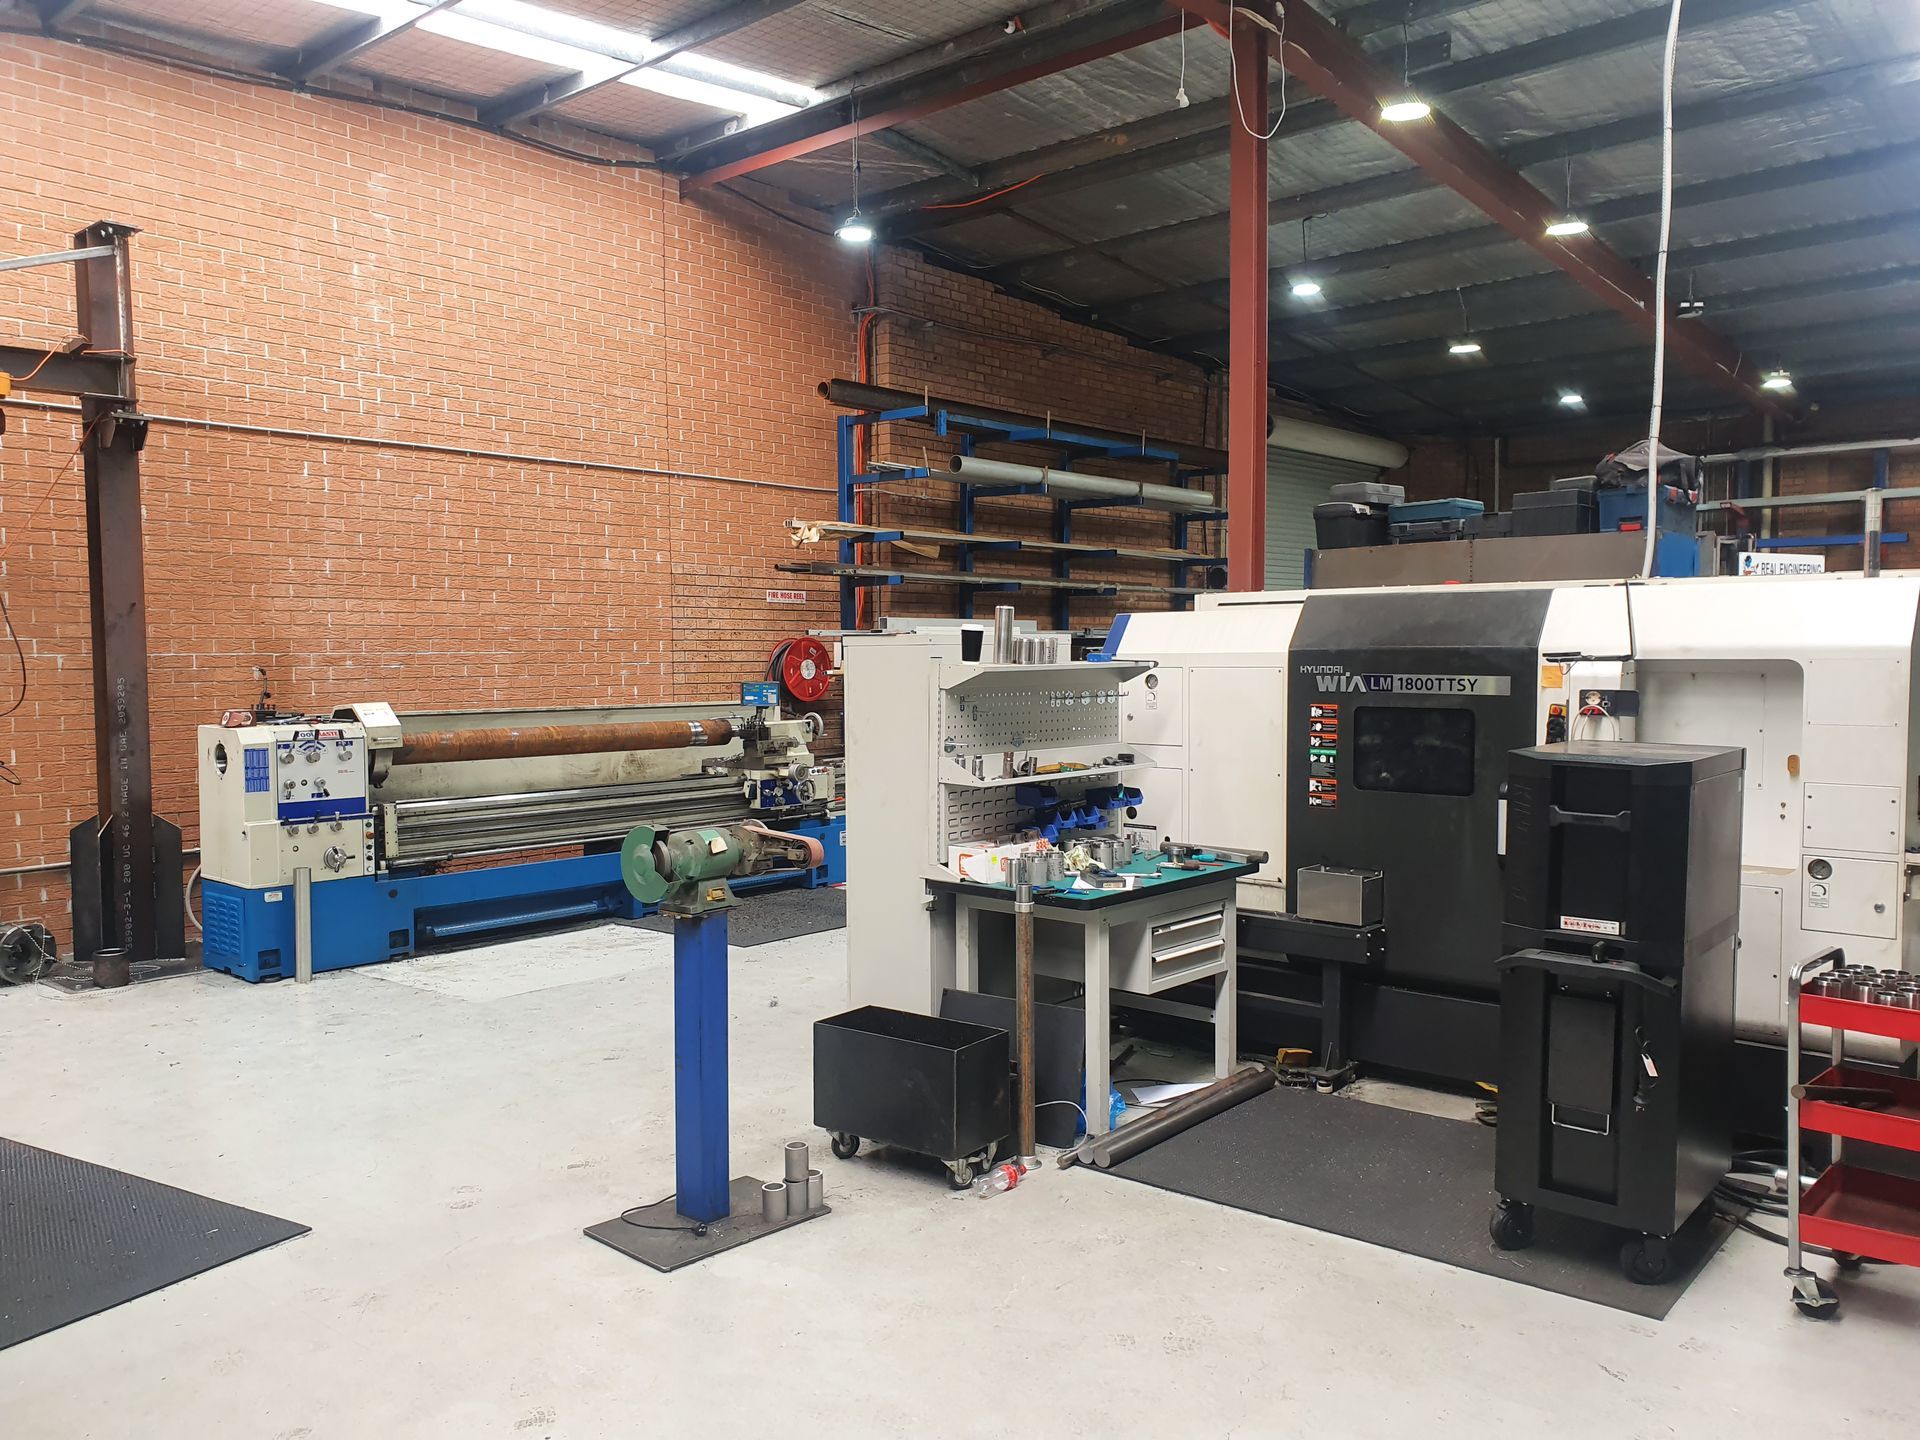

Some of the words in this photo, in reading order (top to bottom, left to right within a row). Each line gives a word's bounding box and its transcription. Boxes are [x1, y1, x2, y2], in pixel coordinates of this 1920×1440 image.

[768, 591, 779, 599] FIRE
[794, 592, 804, 600] REEL
[1299, 665, 1343, 674] HYUNDAI
[1370, 680, 1392, 691] LM
[1397, 677, 1478, 693] 1800TTSY
[120, 757, 128, 770] IN
[120, 778, 129, 804] MADE
[122, 844, 131, 857] UC
